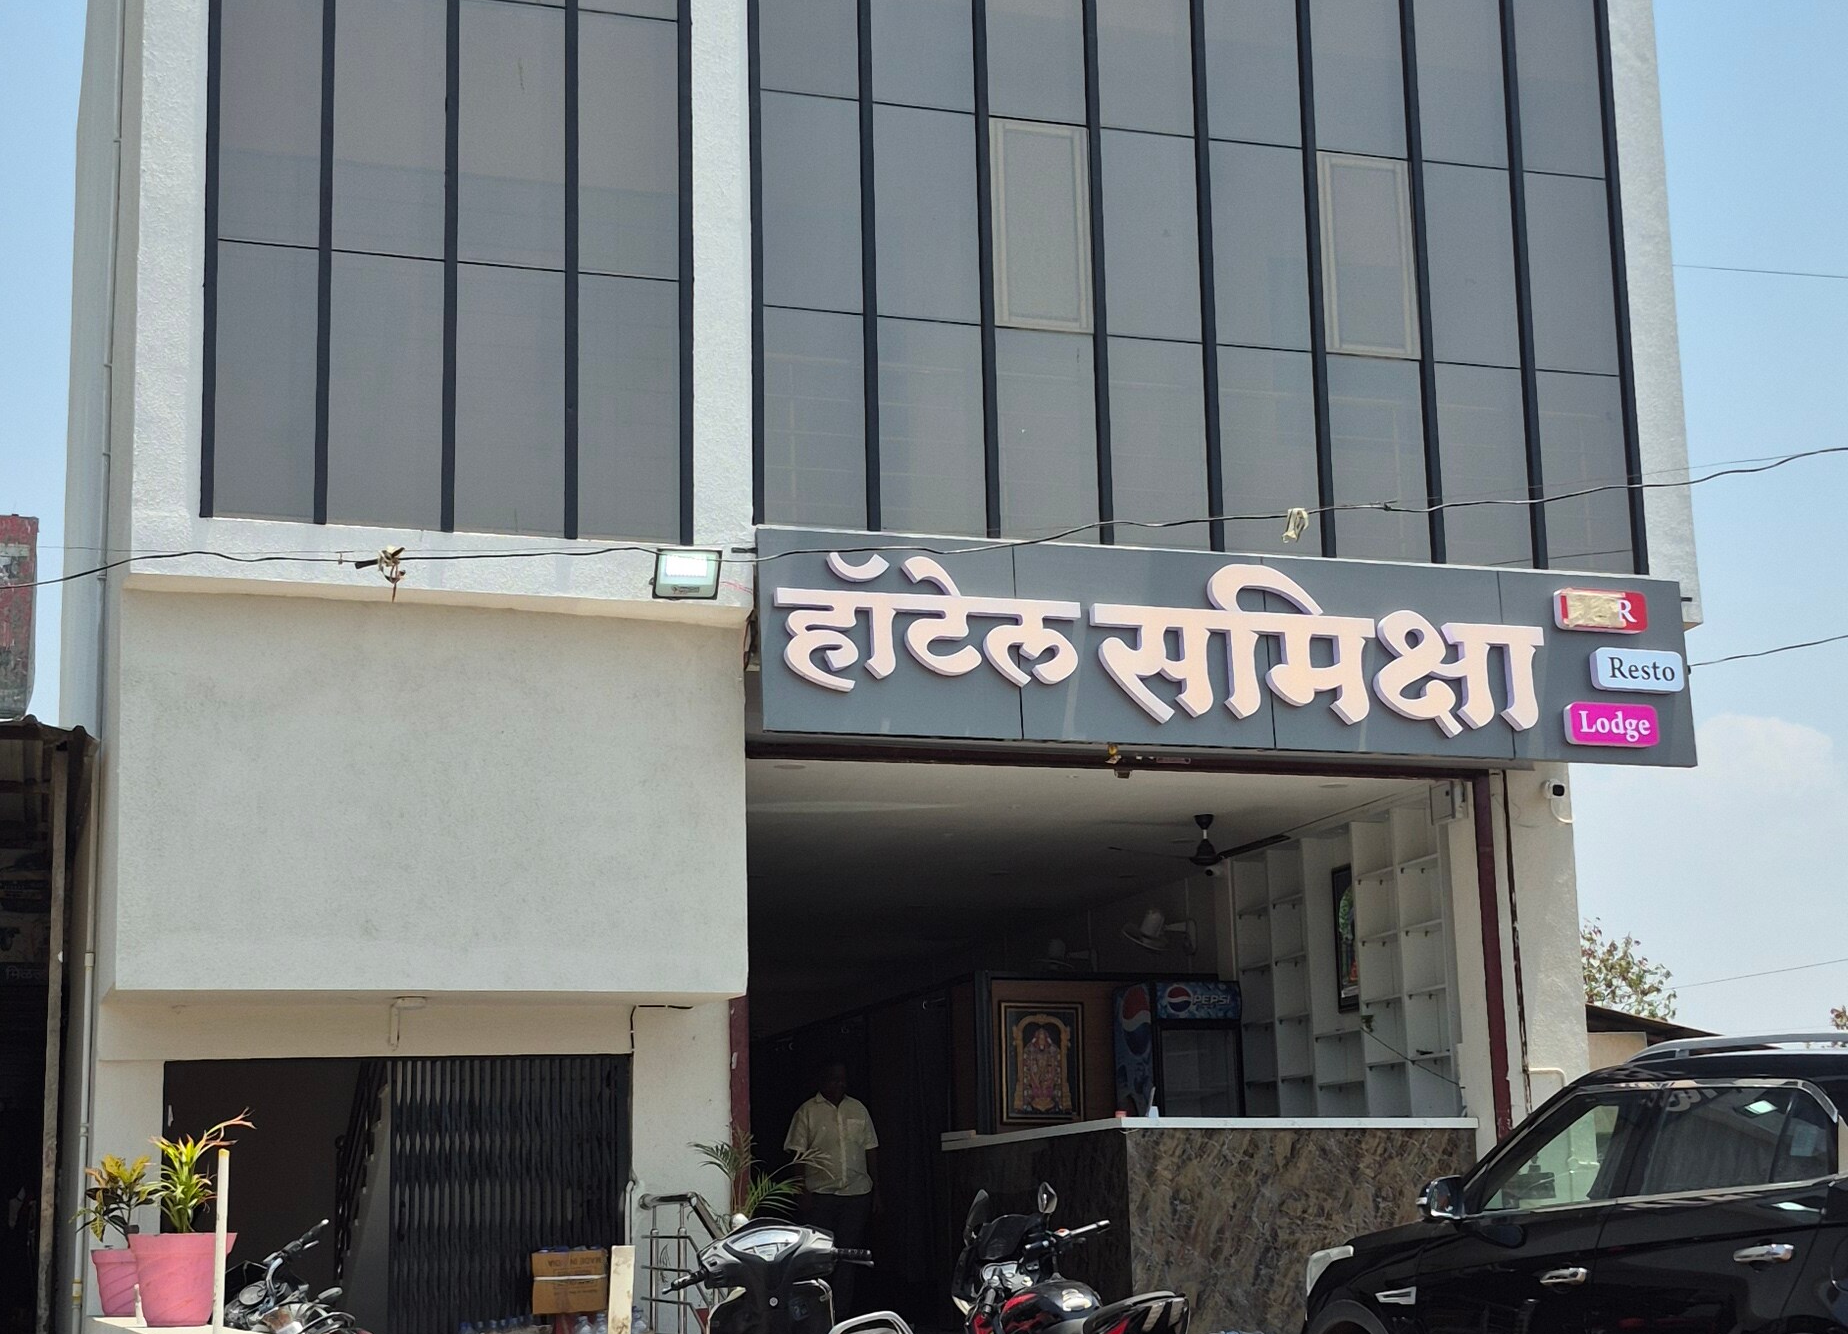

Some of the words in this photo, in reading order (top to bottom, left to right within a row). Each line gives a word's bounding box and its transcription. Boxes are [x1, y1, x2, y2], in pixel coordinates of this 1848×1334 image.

[773, 551, 1081, 692] हॉटेल
[1089, 563, 1544, 738] समिक्षा
[1608, 656, 1676, 682] Resto
[1579, 710, 1651, 742] Lodge
[1193, 995, 1231, 1005] PEPSI
